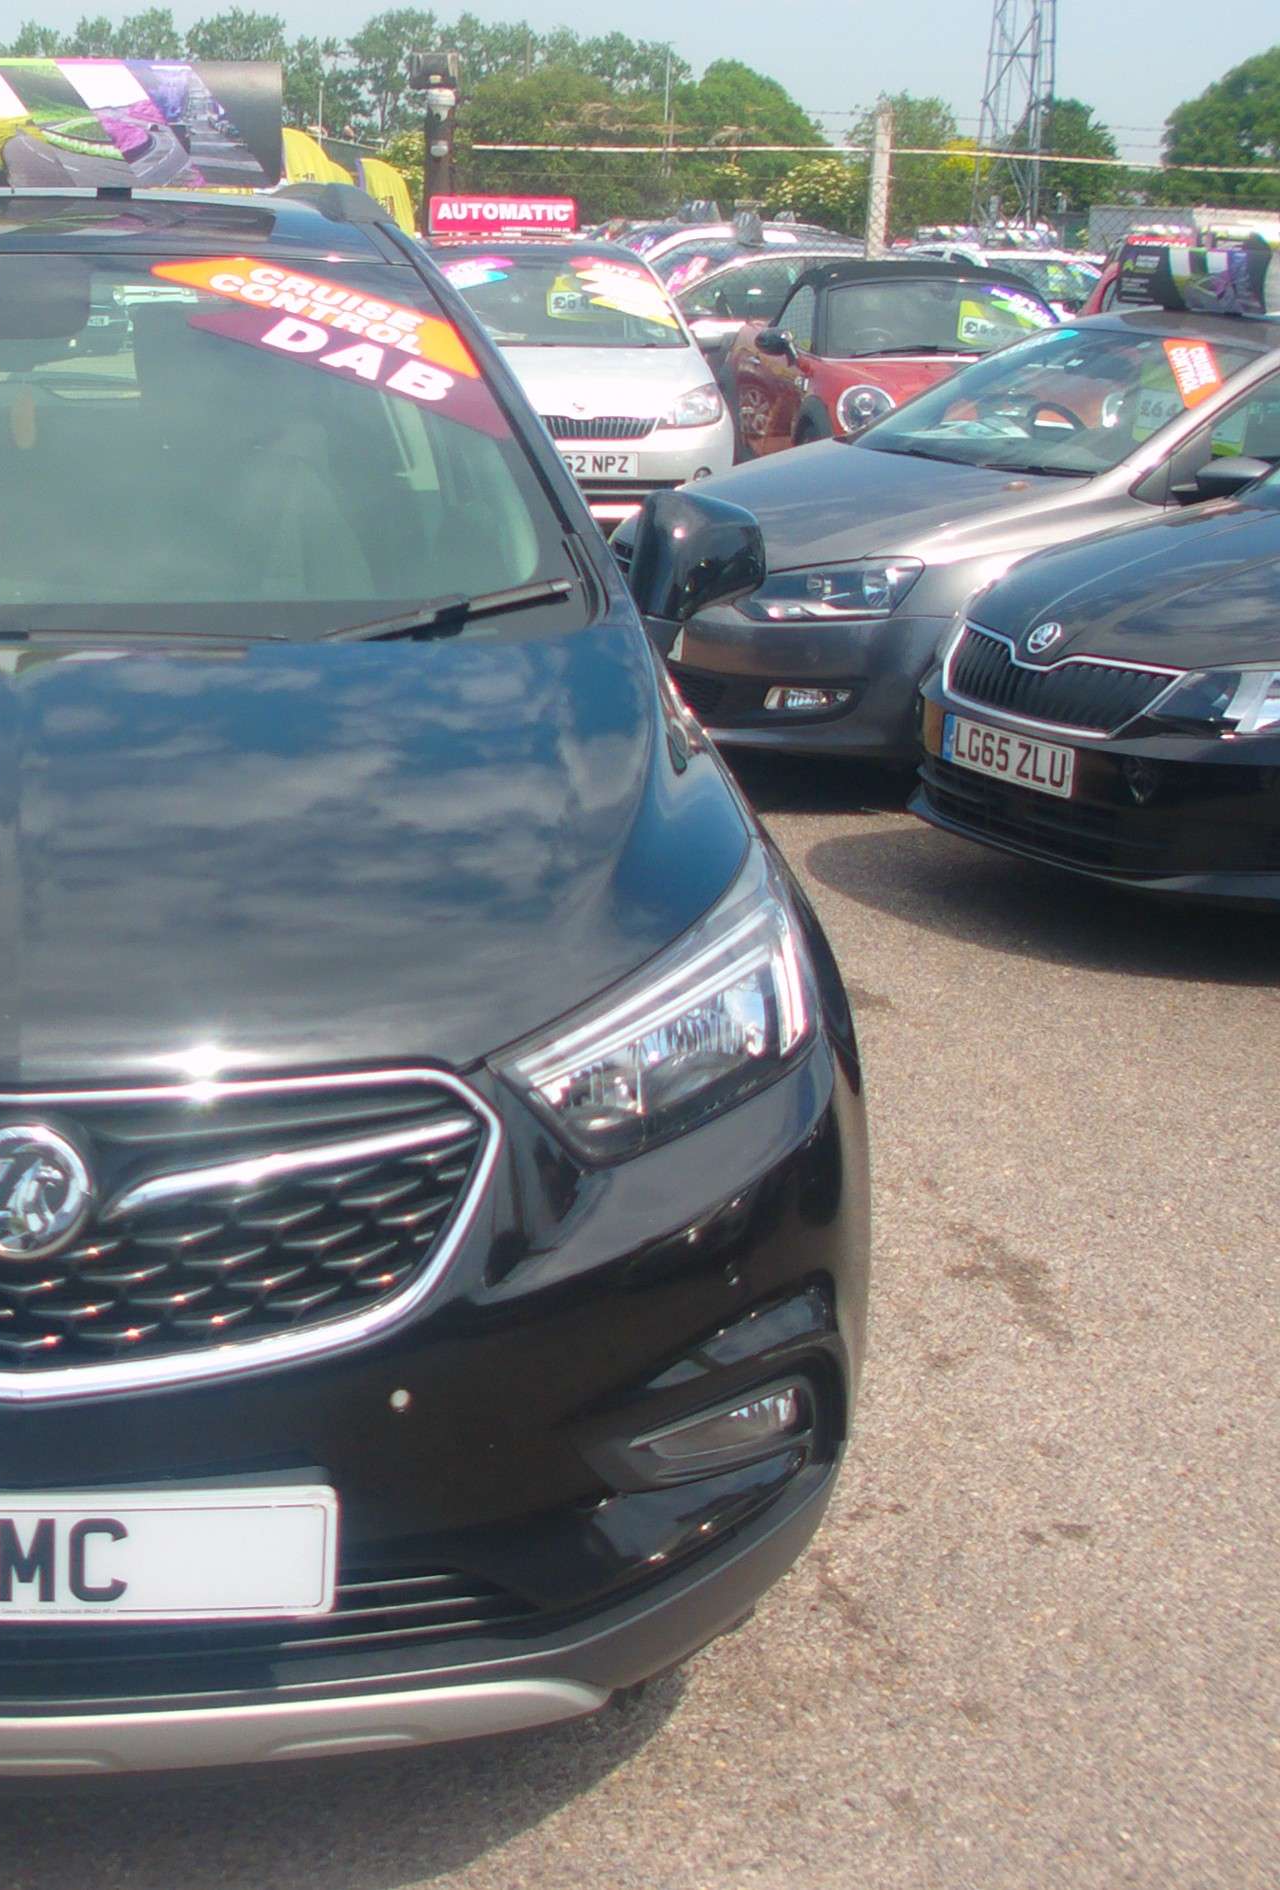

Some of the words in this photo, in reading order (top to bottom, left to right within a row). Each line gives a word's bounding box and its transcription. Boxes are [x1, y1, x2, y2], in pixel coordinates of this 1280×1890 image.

[436, 202, 575, 221] AUTOMATIC
[208, 273, 422, 356] CONTROL
[248, 267, 425, 333] CRUISE
[261, 316, 455, 402] DAB
[591, 455, 629, 473] NPZ
[954, 722, 1012, 772] LG65
[1015, 741, 1067, 788] ZLU
